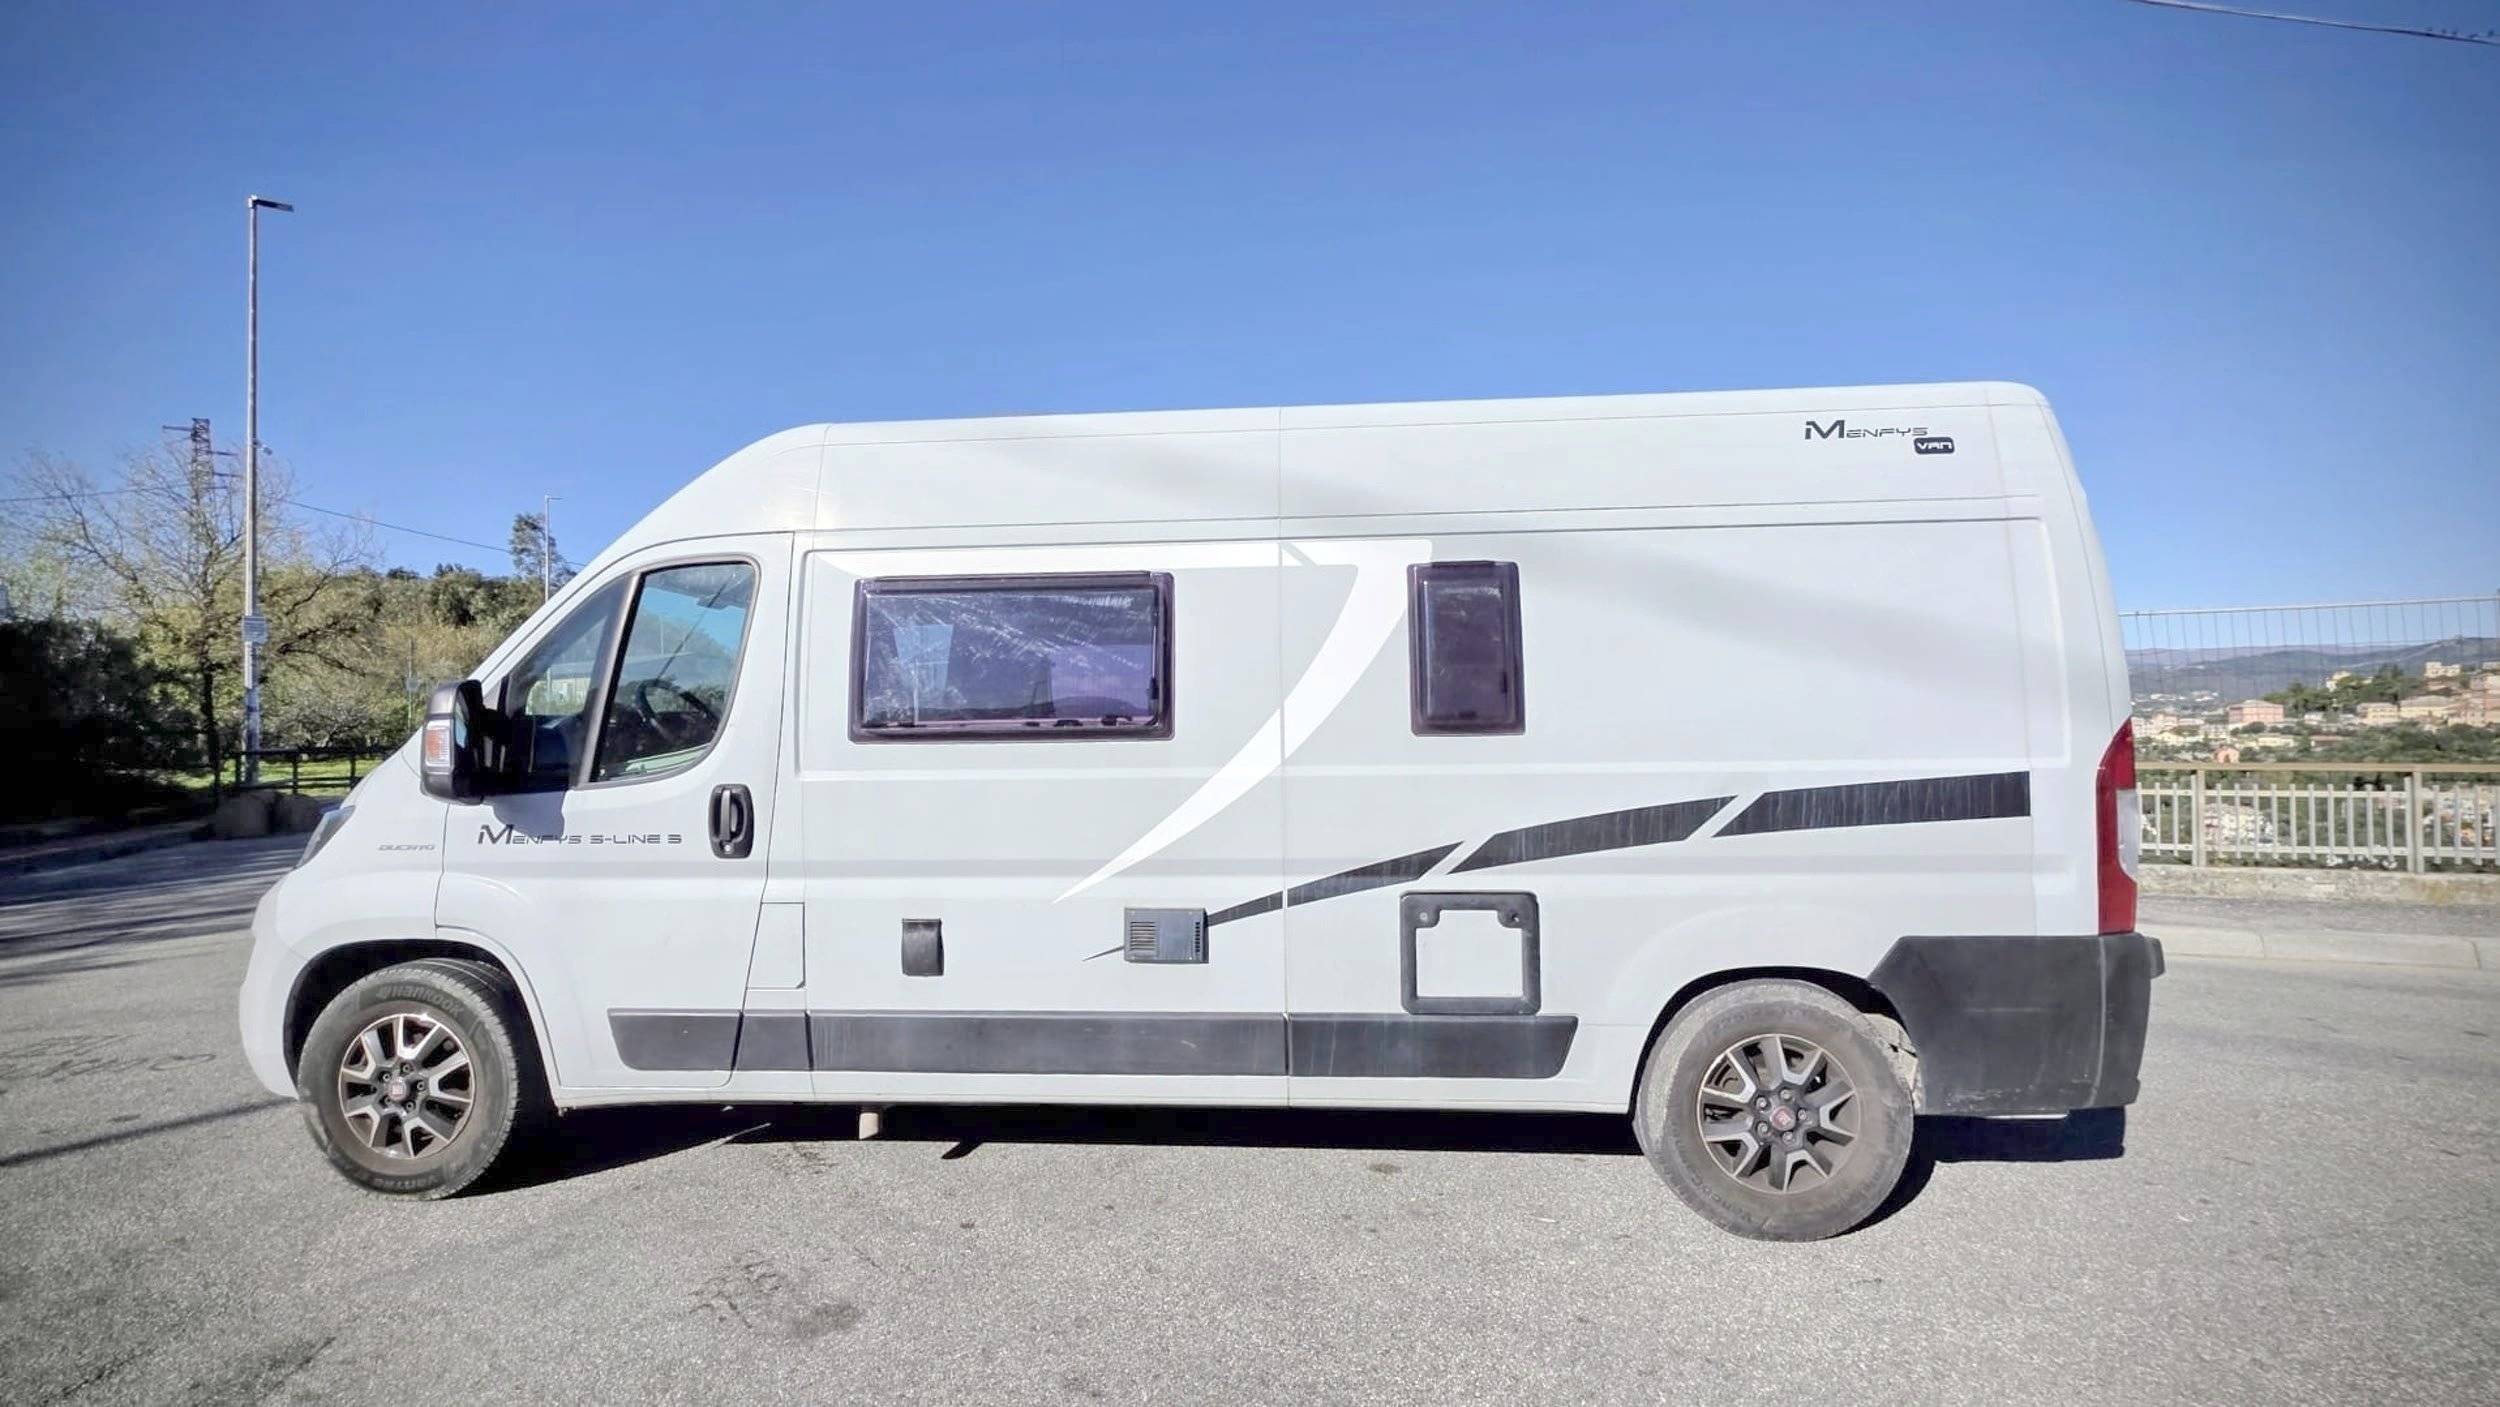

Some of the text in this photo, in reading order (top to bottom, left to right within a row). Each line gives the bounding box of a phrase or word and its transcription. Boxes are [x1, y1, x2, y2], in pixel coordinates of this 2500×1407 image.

[1804, 419, 1929, 440] MENFYS
[478, 823, 683, 845] MENFYS S-LINE 3
